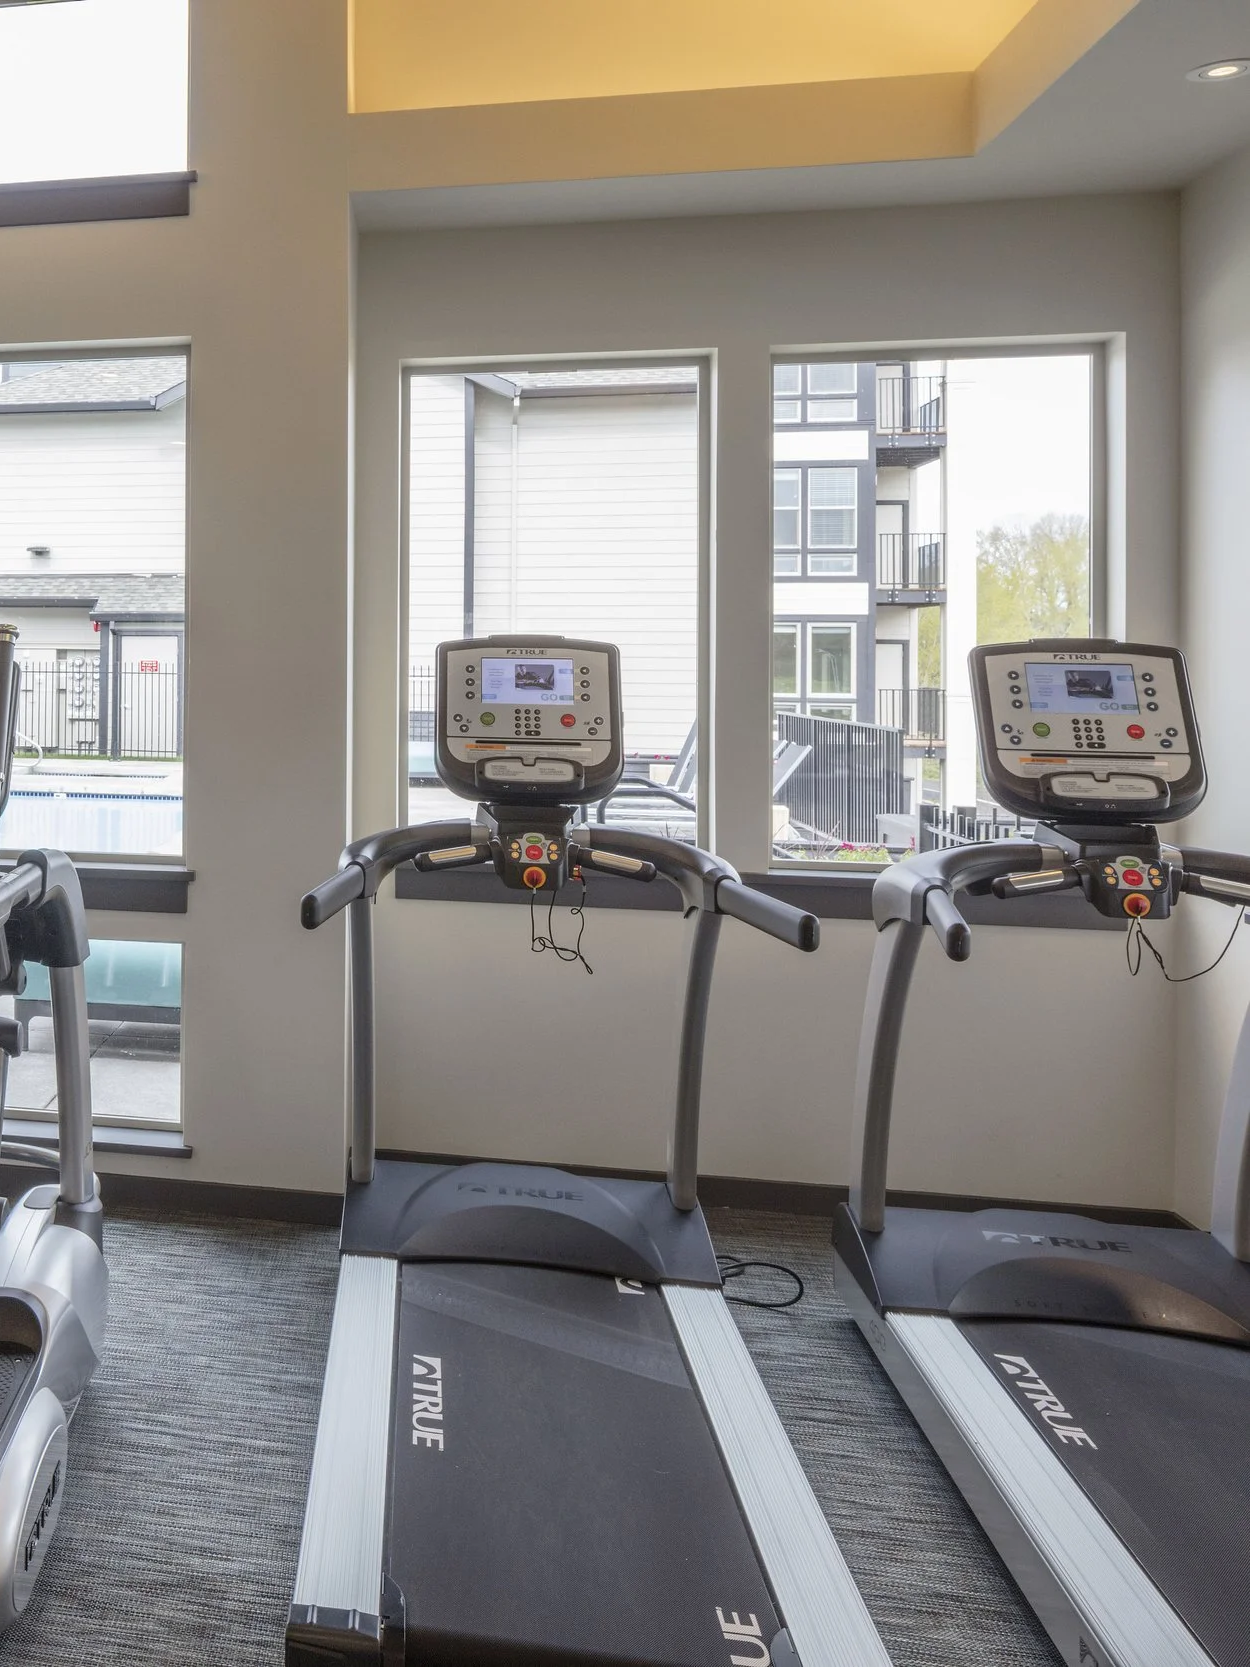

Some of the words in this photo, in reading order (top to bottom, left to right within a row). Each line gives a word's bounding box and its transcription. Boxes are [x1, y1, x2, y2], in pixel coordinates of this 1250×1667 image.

[540, 693, 558, 701] GO
[1099, 702, 1120, 711] GO
[490, 1184, 585, 1201] TRUE
[1019, 1233, 1133, 1253] TRUE
[412, 1379, 444, 1452] TRUE
[1015, 1378, 1099, 1451] TRUE
